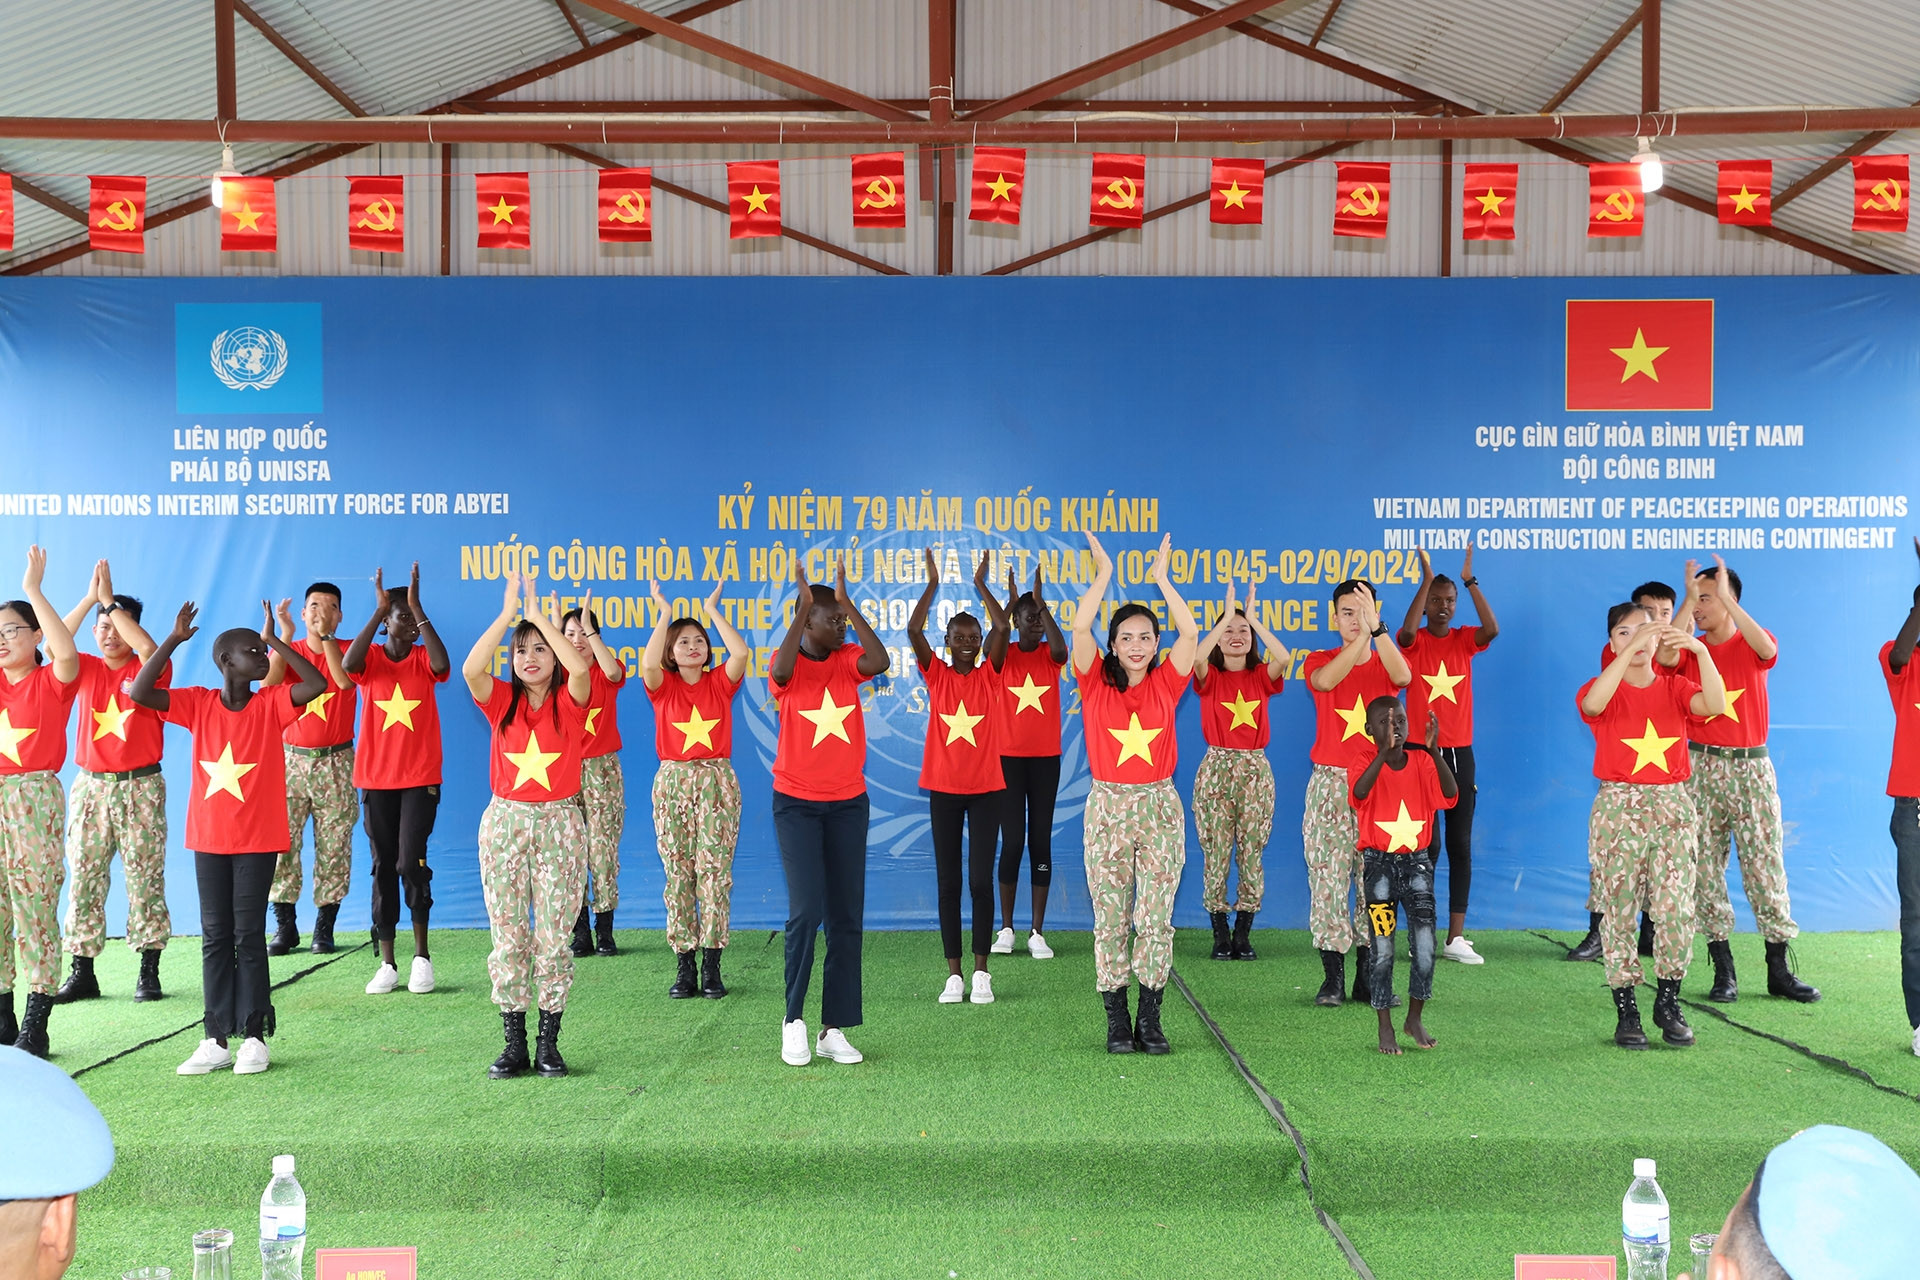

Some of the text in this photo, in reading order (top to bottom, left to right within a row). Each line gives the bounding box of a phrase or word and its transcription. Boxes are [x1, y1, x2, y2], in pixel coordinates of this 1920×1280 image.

[174, 421, 328, 454] LIÊN HỢP QUỐC
[1475, 420, 1803, 452] CỤC GÌN GIỮ HÒA BÌNH VIỆT NAM
[171, 456, 331, 486] PHÁI BỘ UNISFA
[1563, 453, 1715, 484] ĐỘI CÔNG BINH
[0, 493, 509, 516] NITED NATIONS INTERIM SECURITY FORCE FOR ABYEI
[718, 481, 1159, 538] KỶ NIỆM 79 NĂM QUỐC KHÁNH
[1373, 495, 1908, 519] VIETNAM DEPARTMENT OF PEACEKEEPING OPERATIONS
[1384, 527, 1896, 550] MILITARY CONSTRUCTION ENGINEERING CONTINGENT
[461, 533, 539, 581] NƯỚC
[548, 538, 626, 588] CỘNG
[636, 538, 694, 581] HÒA
[702, 540, 740, 581] XÃ
[750, 541, 797, 589] HỘI
[807, 536, 864, 583] CHỦ
[874, 541, 962, 584] NGHĨA
[970, 542, 1031, 590] VIỆT
[1039, 549, 1100, 584] NAM
[672, 597, 712, 630] ON
[720, 598, 773, 630] THE
